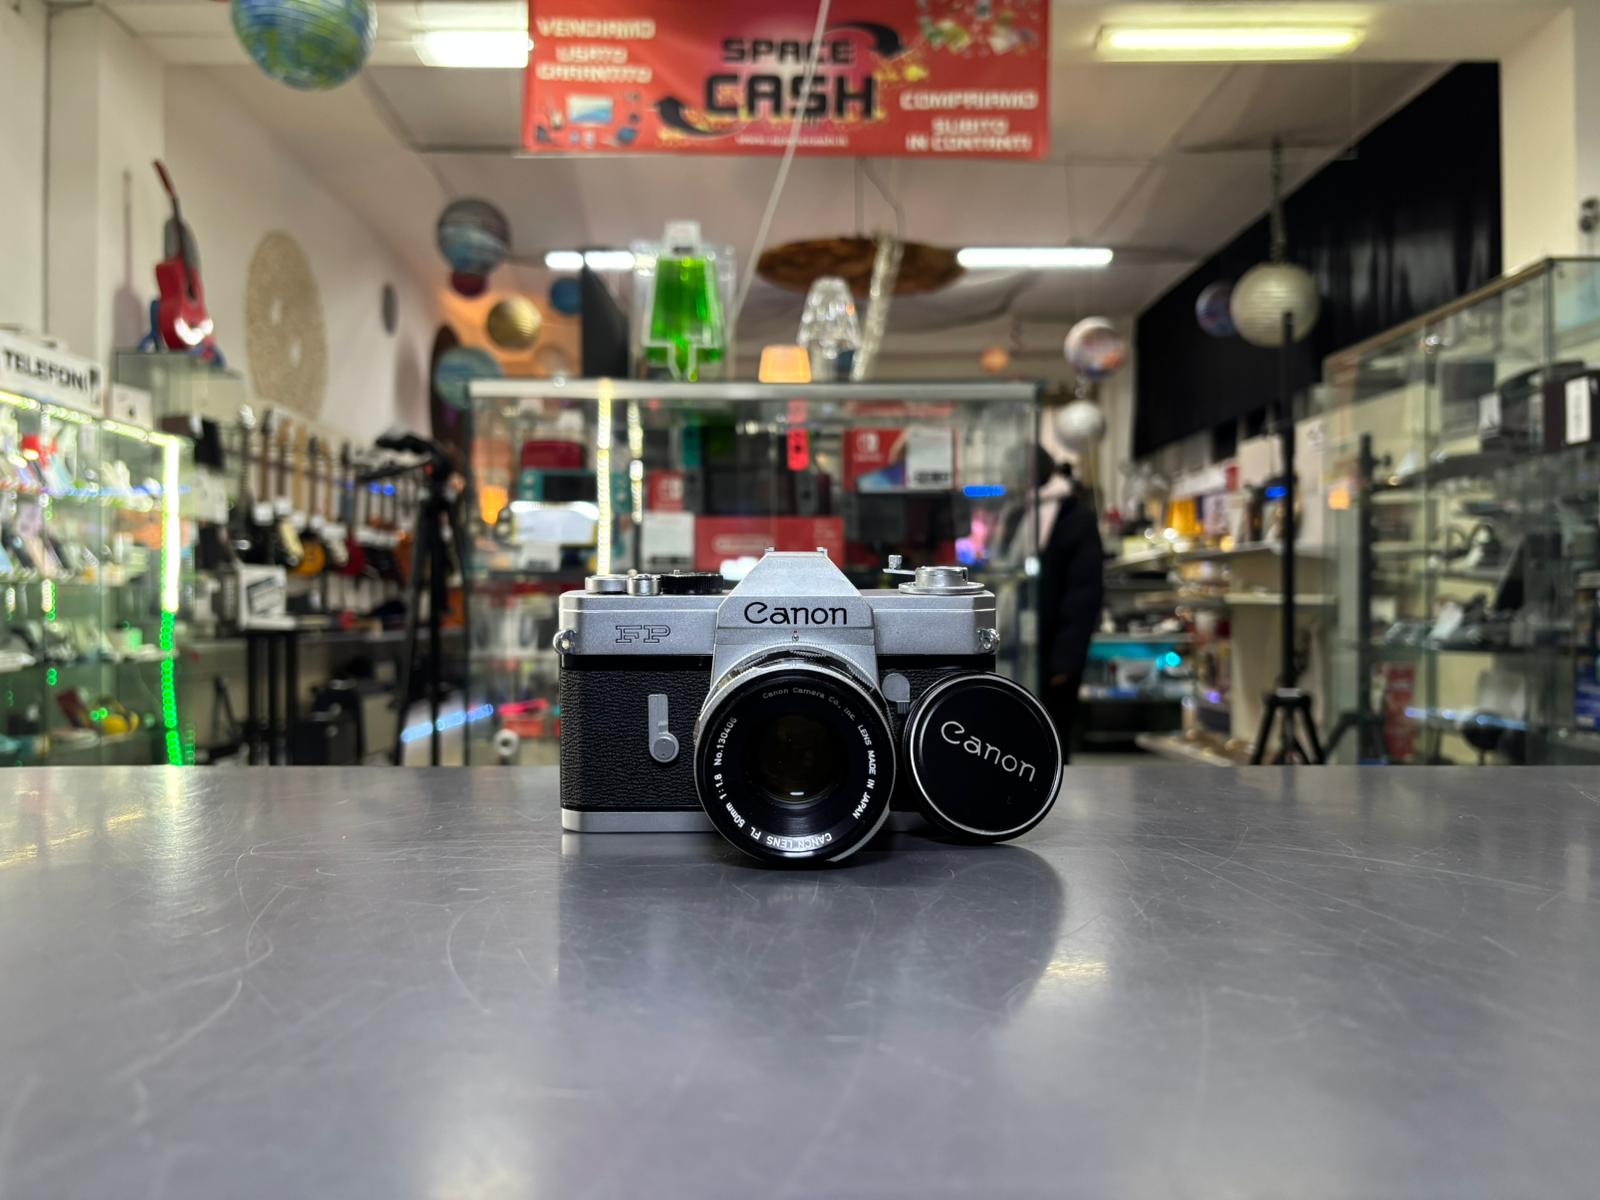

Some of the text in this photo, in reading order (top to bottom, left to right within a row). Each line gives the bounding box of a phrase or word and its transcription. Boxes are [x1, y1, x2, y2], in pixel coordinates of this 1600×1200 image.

[722, 38, 853, 63] SPACE
[706, 75, 875, 119] CASH
[744, 601, 848, 625] Canon
[615, 624, 671, 643] FP
[762, 688, 789, 699] Canon
[792, 687, 825, 699] Camera
[941, 721, 1036, 782] Canon
[852, 724, 877, 819] LENS MADE IN JAPAN
[725, 802, 746, 828] 50mm
[750, 826, 762, 840] FL
[766, 835, 793, 846] LENS
